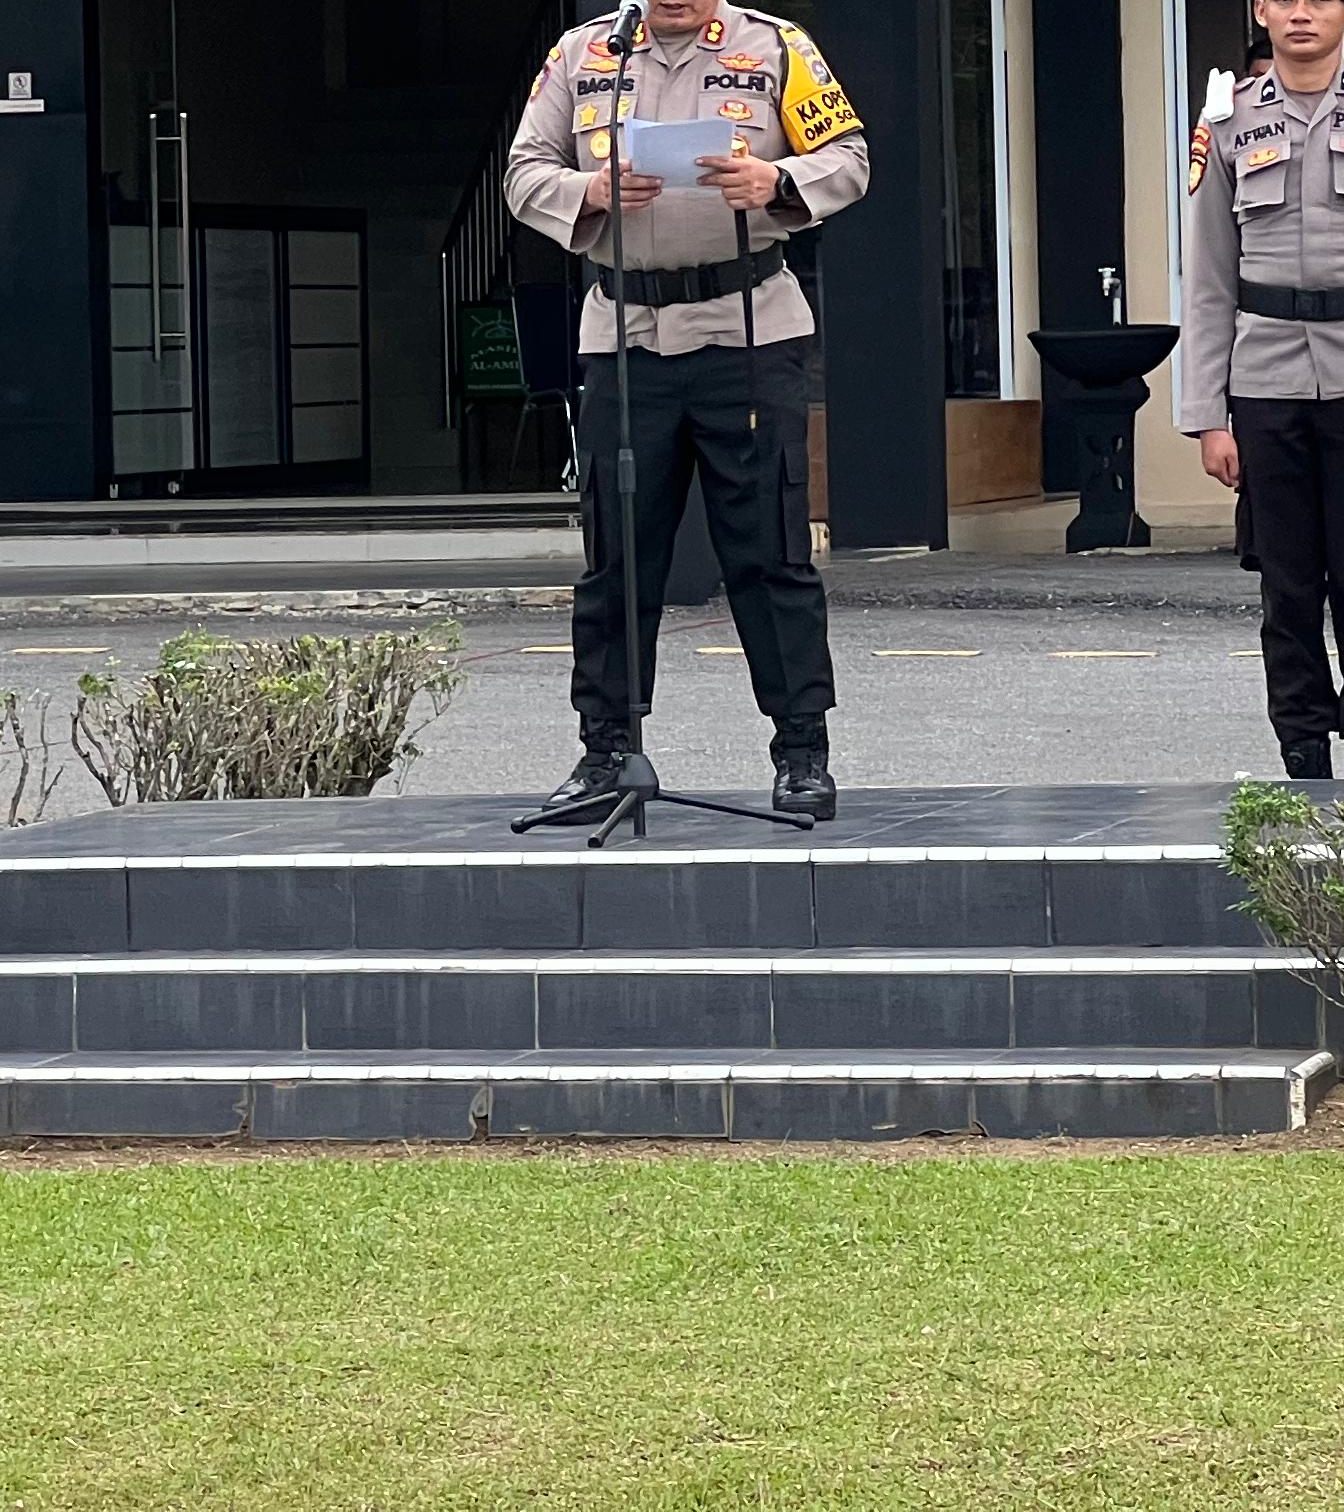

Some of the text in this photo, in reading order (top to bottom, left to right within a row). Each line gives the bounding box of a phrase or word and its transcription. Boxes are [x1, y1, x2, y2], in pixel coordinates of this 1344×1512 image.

[704, 74, 767, 92] POLRI
[796, 99, 823, 124] KA
[805, 117, 833, 141] OMP
[1234, 121, 1286, 150] AFWAN
